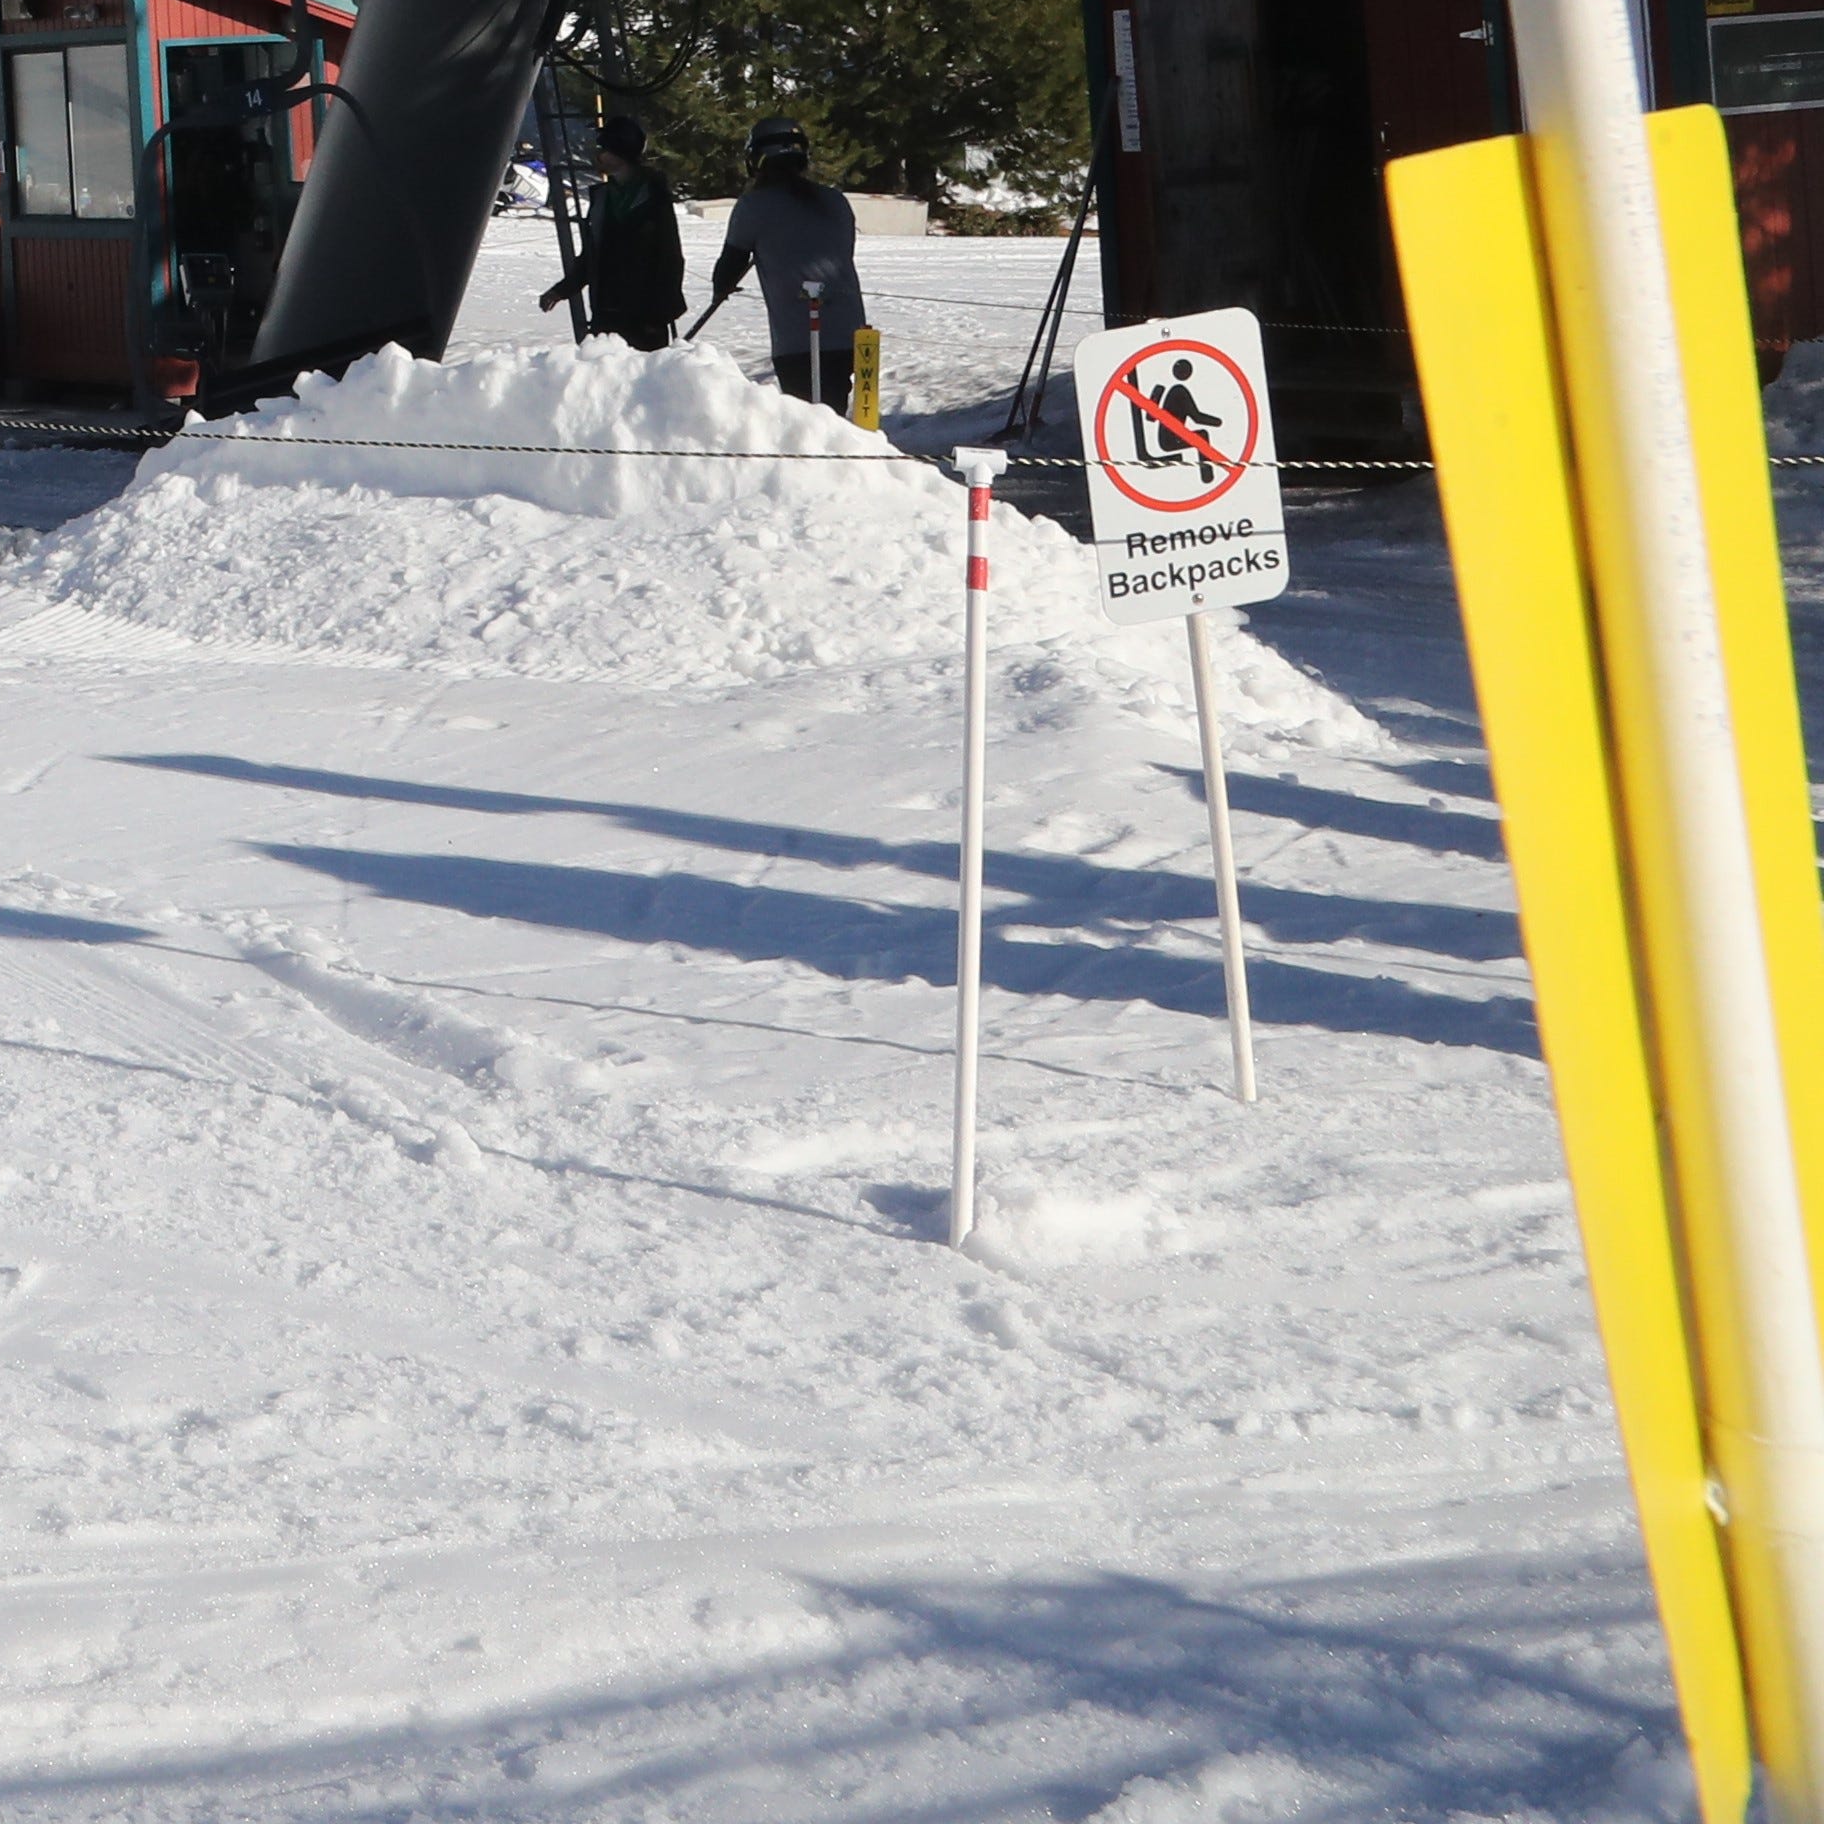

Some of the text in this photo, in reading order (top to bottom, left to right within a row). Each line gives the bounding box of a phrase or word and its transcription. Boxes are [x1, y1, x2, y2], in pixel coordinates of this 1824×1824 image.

[245, 88, 262, 108] 14
[861, 367, 873, 418] WAIT
[1126, 517, 1255, 559] Remove
[1108, 548, 1281, 599] Backpacks
